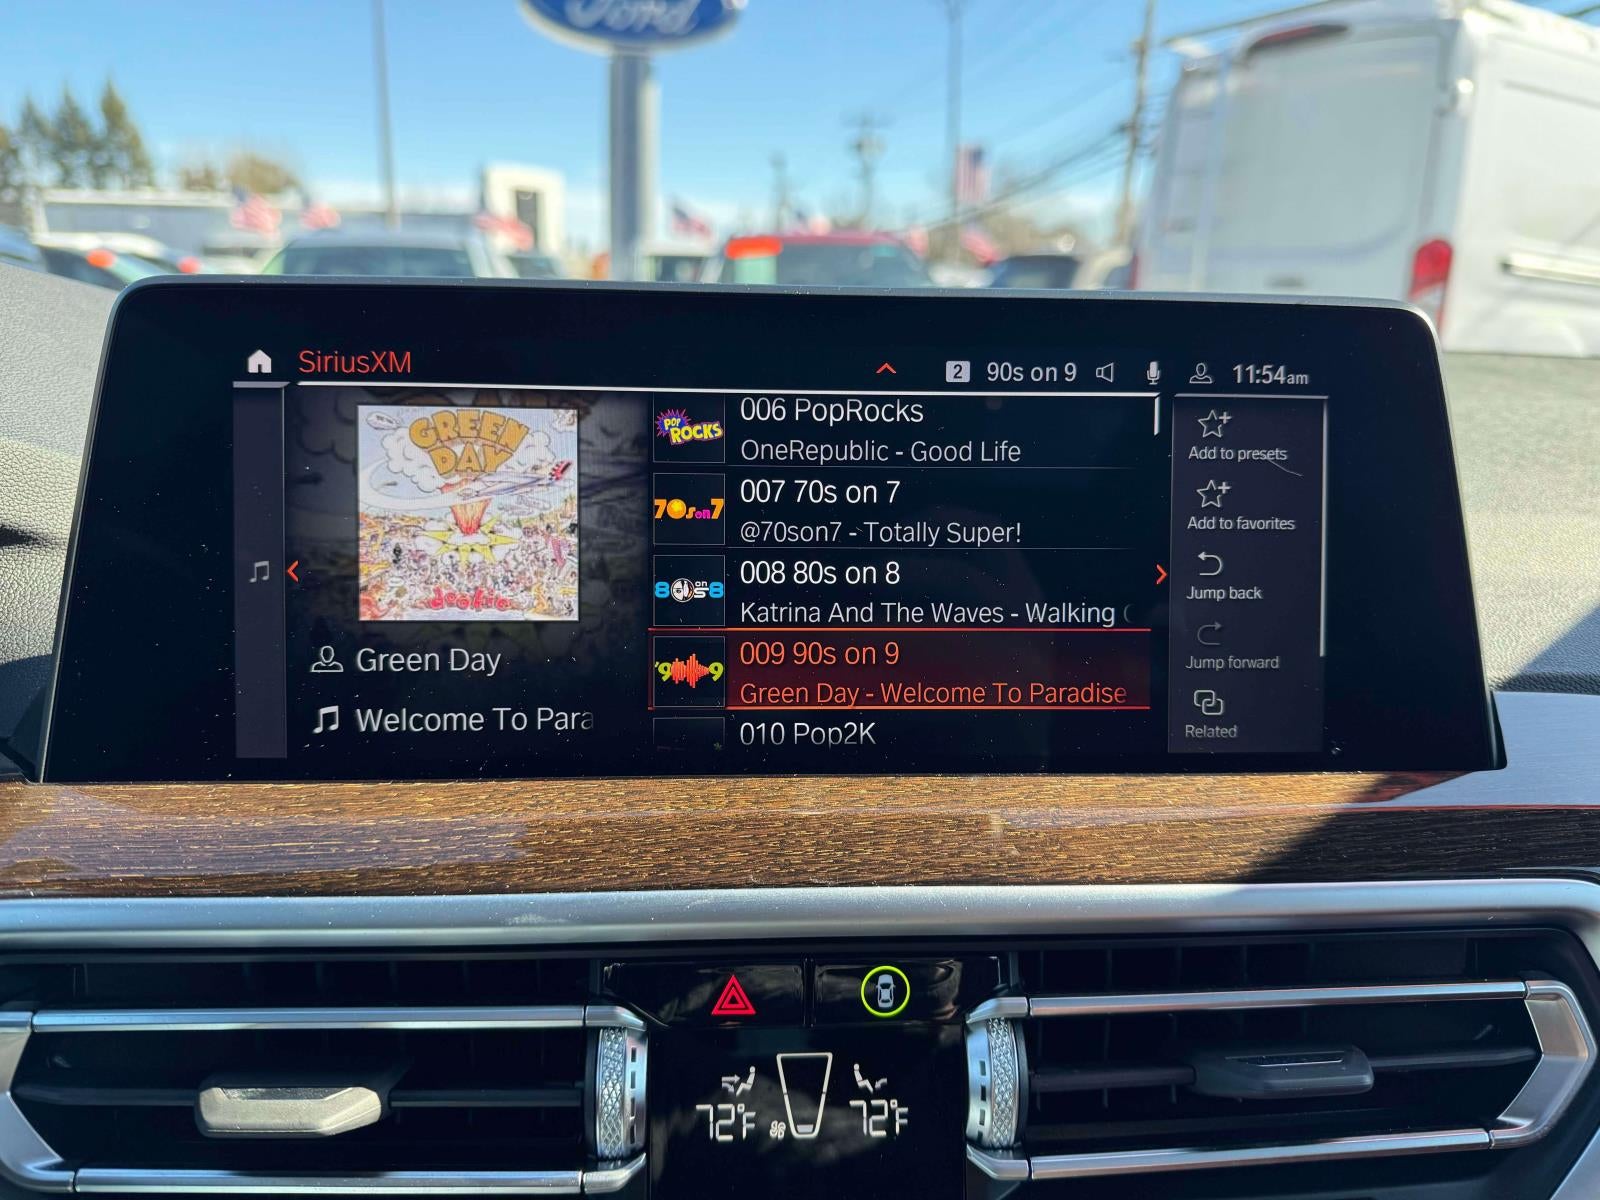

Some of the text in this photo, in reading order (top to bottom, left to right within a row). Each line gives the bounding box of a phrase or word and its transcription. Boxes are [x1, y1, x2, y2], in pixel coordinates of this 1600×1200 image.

[298, 350, 411, 374] SiriusXM
[986, 361, 1077, 382] 90s on 9
[1232, 363, 1309, 385] 11:54am
[740, 396, 924, 427] 006 PopRocks
[409, 409, 529, 452] GREEN
[669, 422, 723, 444] ROCKS
[429, 442, 514, 476] DAY
[741, 439, 889, 465] OneRepublic
[910, 440, 973, 463] Good
[981, 440, 1021, 462] Life
[1188, 445, 1288, 463] Add to presets
[740, 478, 901, 504] 007 70s on 7
[740, 520, 842, 543] @70son7
[863, 521, 940, 547] Totally
[945, 522, 1022, 547] Super!
[1187, 515, 1296, 530] Add to favorites
[740, 560, 901, 585] 008 80s on 8
[1186, 585, 1262, 602] Jump back
[741, 601, 821, 623] Katrina
[827, 601, 874, 623] And
[880, 601, 924, 623] The
[930, 602, 1004, 624] Waves
[1025, 602, 1116, 628] Walking
[355, 647, 502, 677] Green Day
[739, 641, 900, 665] 009 90s on 9
[1185, 654, 1280, 671] Jump forward
[740, 682, 809, 704] Green
[817, 682, 860, 707] Day
[880, 682, 987, 704] Welcome
[991, 682, 1022, 704] To
[1030, 682, 1126, 704] Paradise
[355, 707, 594, 733] Welcome To Para
[1185, 723, 1238, 738] Related
[740, 721, 877, 749] 010 Pop2K
